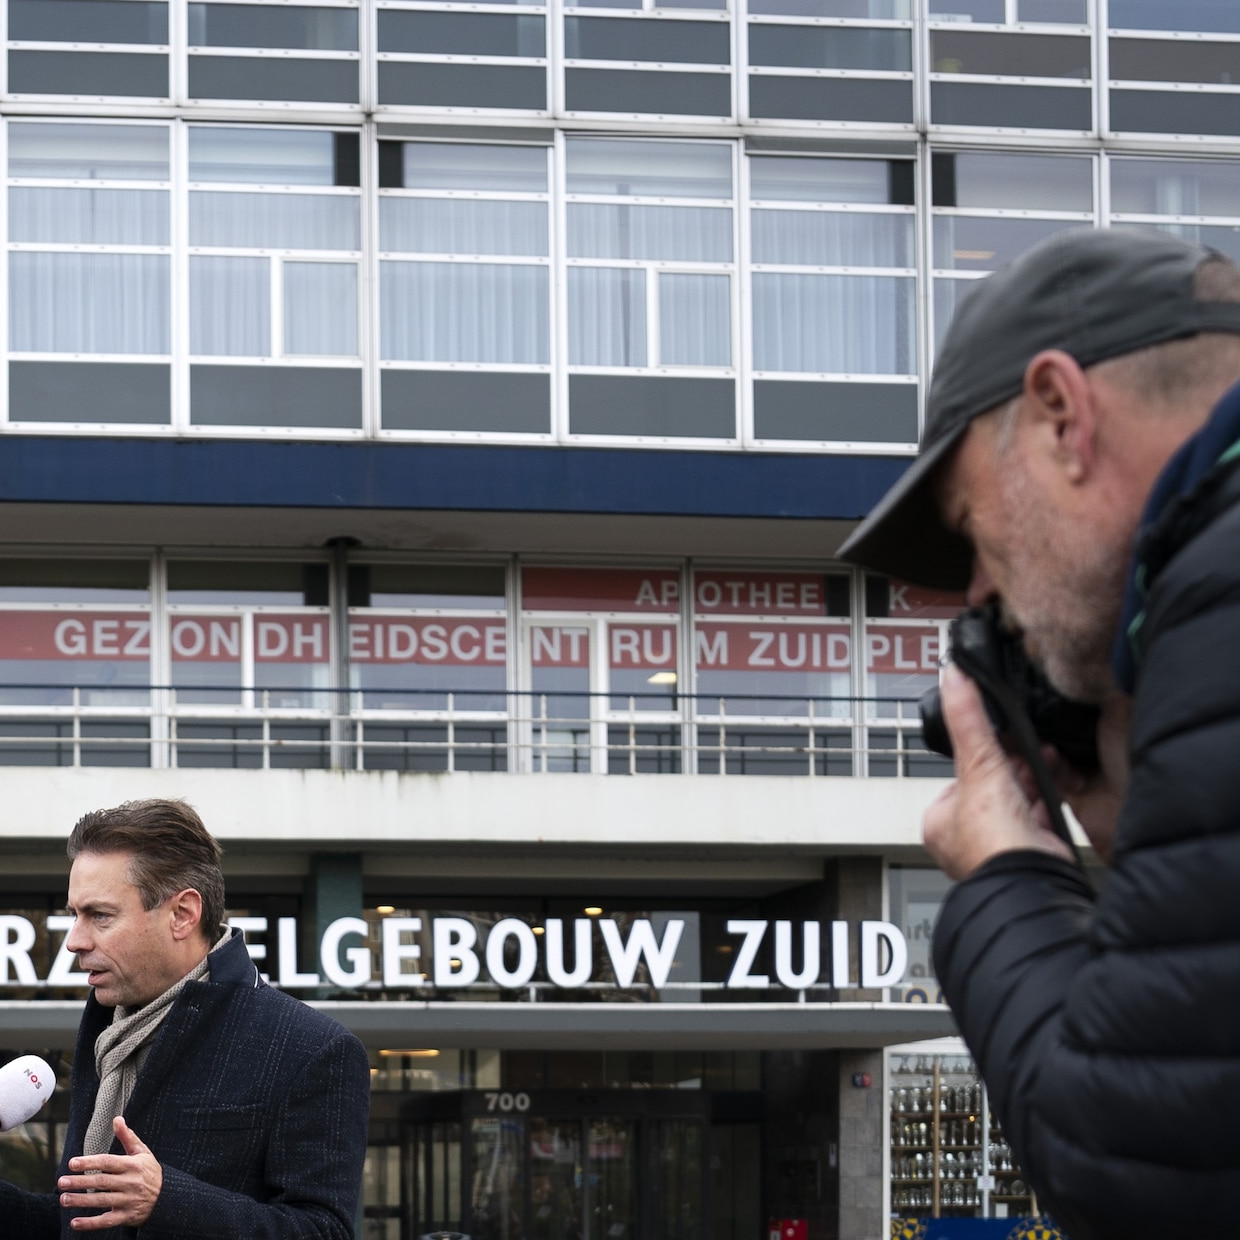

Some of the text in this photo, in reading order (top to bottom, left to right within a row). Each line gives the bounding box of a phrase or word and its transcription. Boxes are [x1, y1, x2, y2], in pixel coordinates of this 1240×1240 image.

[725, 919, 909, 989] ZUID
[23, 1069, 43, 1090] NOS
[484, 1092, 531, 1111] 700
